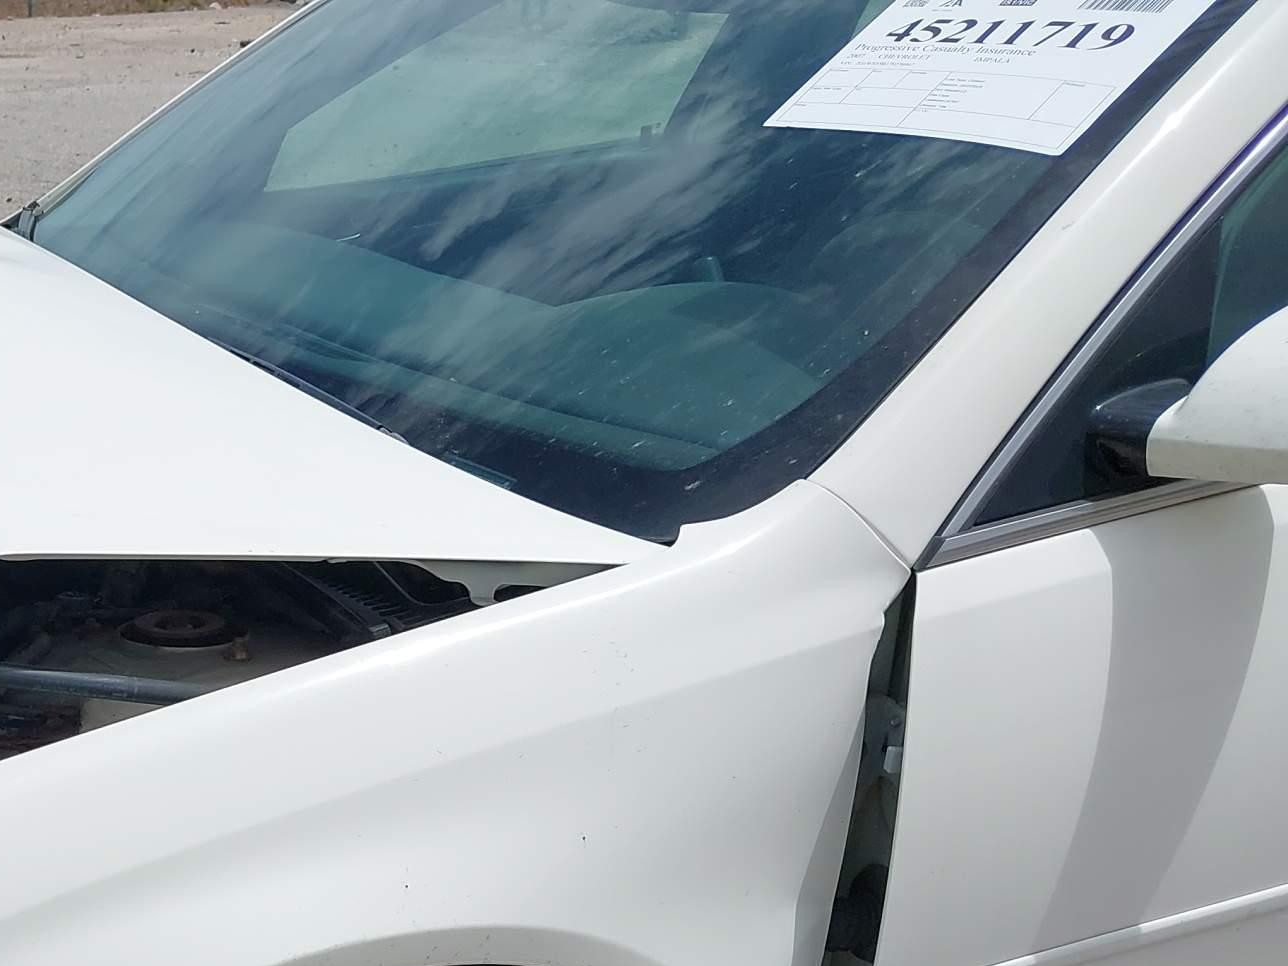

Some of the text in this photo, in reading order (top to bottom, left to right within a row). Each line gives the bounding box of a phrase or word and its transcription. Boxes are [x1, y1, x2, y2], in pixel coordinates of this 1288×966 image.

[885, 18, 1136, 51] 45211719
[855, 43, 1037, 57] Progressive Casualty Insurance
